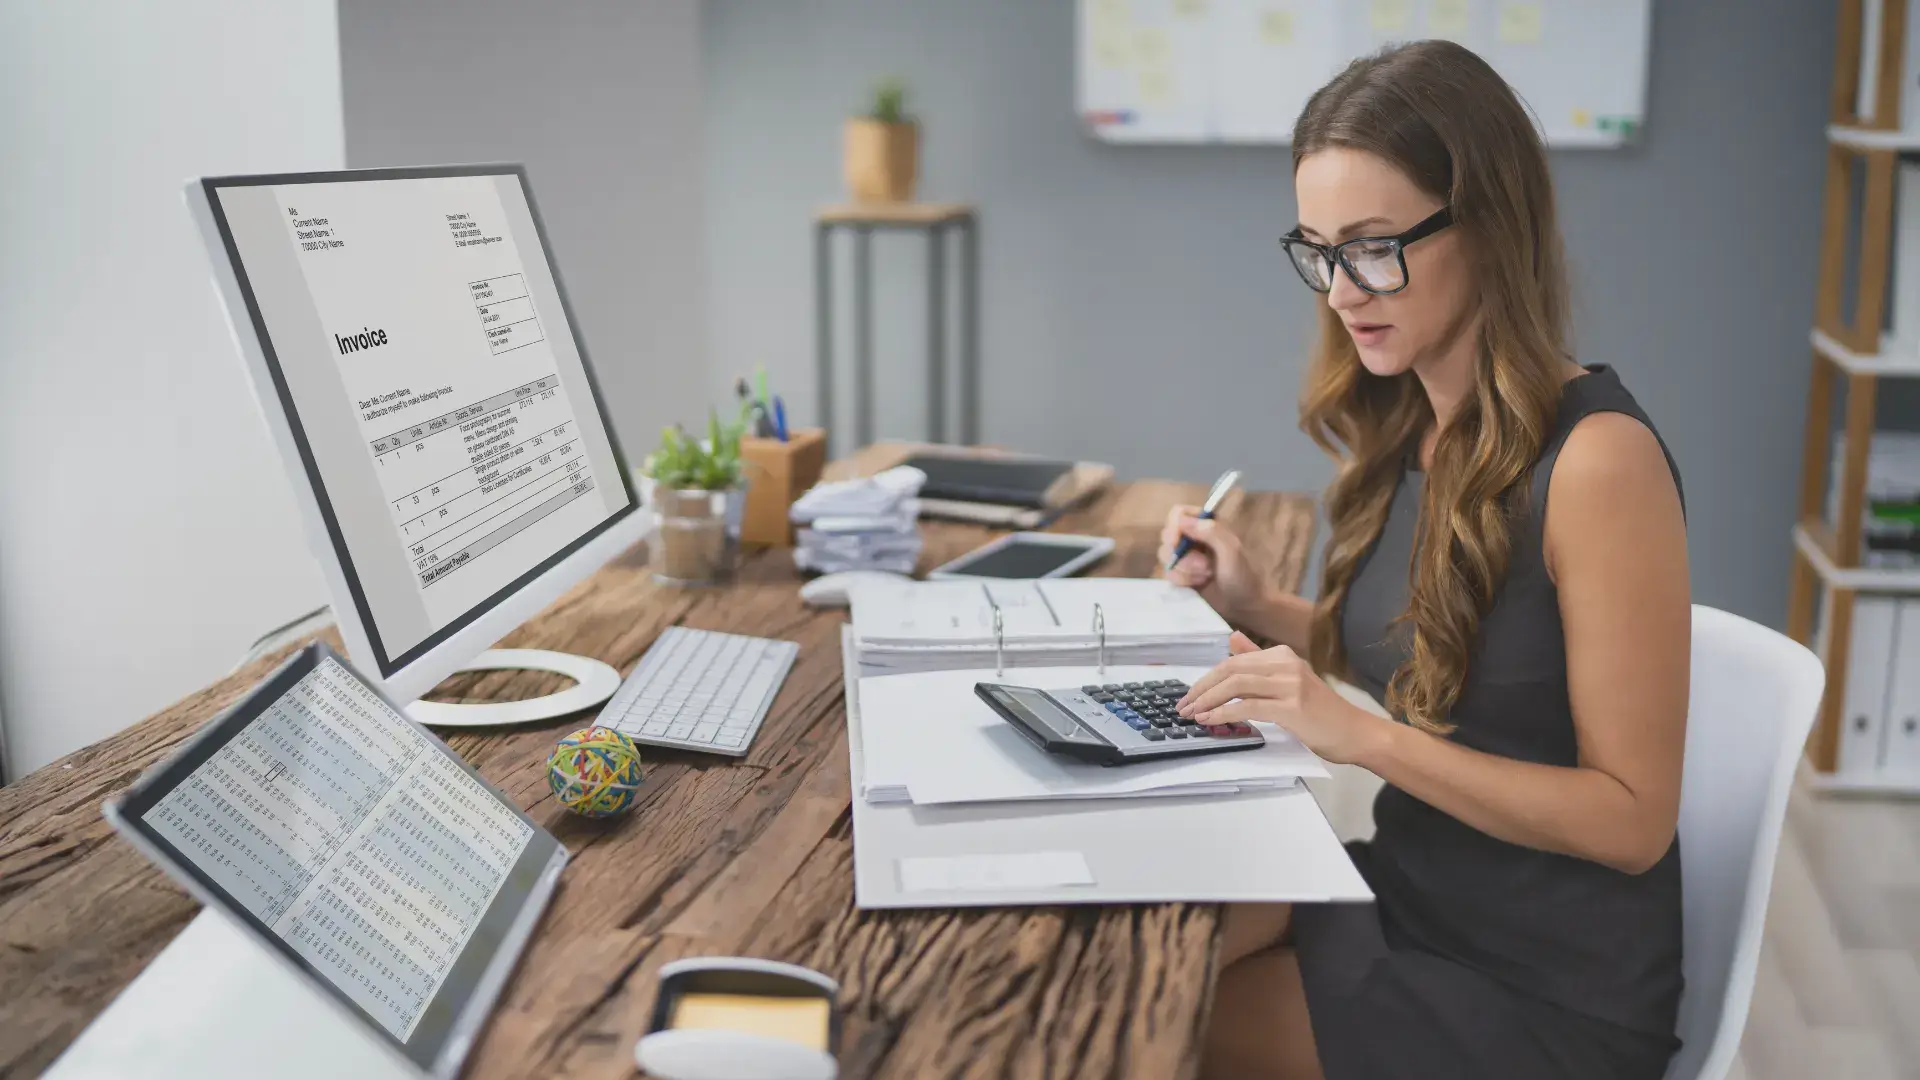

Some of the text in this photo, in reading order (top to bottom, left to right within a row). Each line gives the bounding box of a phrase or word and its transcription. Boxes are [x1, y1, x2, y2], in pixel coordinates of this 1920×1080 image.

[293, 219, 313, 227] Current
[297, 231, 314, 239] Street
[328, 240, 344, 248] Name
[335, 327, 387, 355] Invoice
[359, 401, 371, 409] Dear
[371, 397, 380, 405] Ms
[379, 392, 397, 403] Current
[388, 401, 403, 413] myself
[408, 397, 420, 406] make
[412, 544, 424, 556] Total
[417, 558, 427, 570] VAT
[422, 571, 435, 583] Total
[435, 561, 454, 577] Amount
[452, 552, 470, 570] Payable
